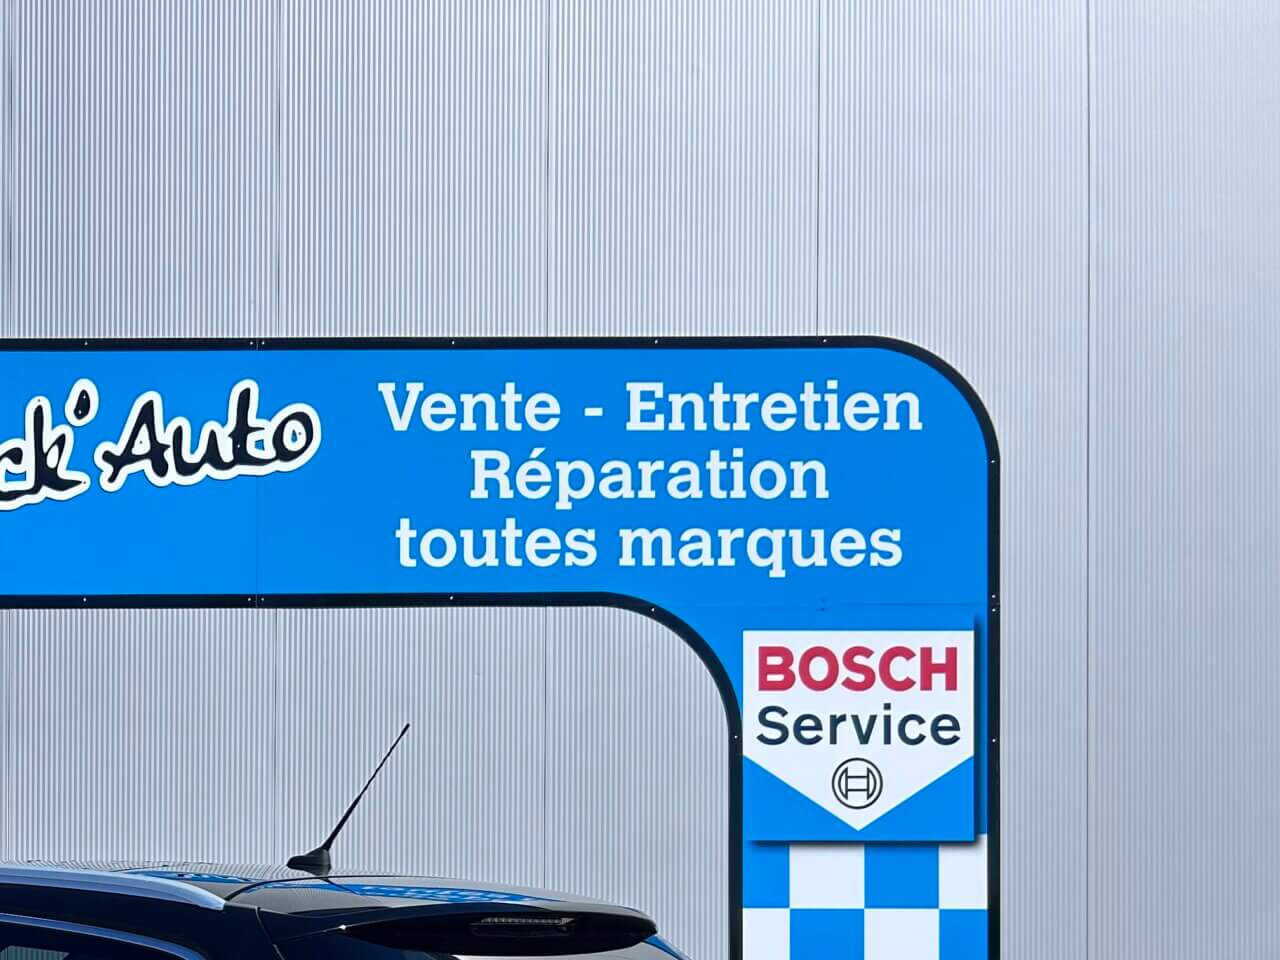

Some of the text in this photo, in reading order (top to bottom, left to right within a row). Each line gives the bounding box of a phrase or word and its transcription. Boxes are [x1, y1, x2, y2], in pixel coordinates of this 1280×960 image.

[379, 382, 561, 432] Vente
[627, 380, 922, 432] Entretien
[471, 448, 828, 510] Réparation
[396, 517, 902, 578] toutes marques
[758, 646, 958, 692] BOSCH
[757, 702, 961, 746] Service
